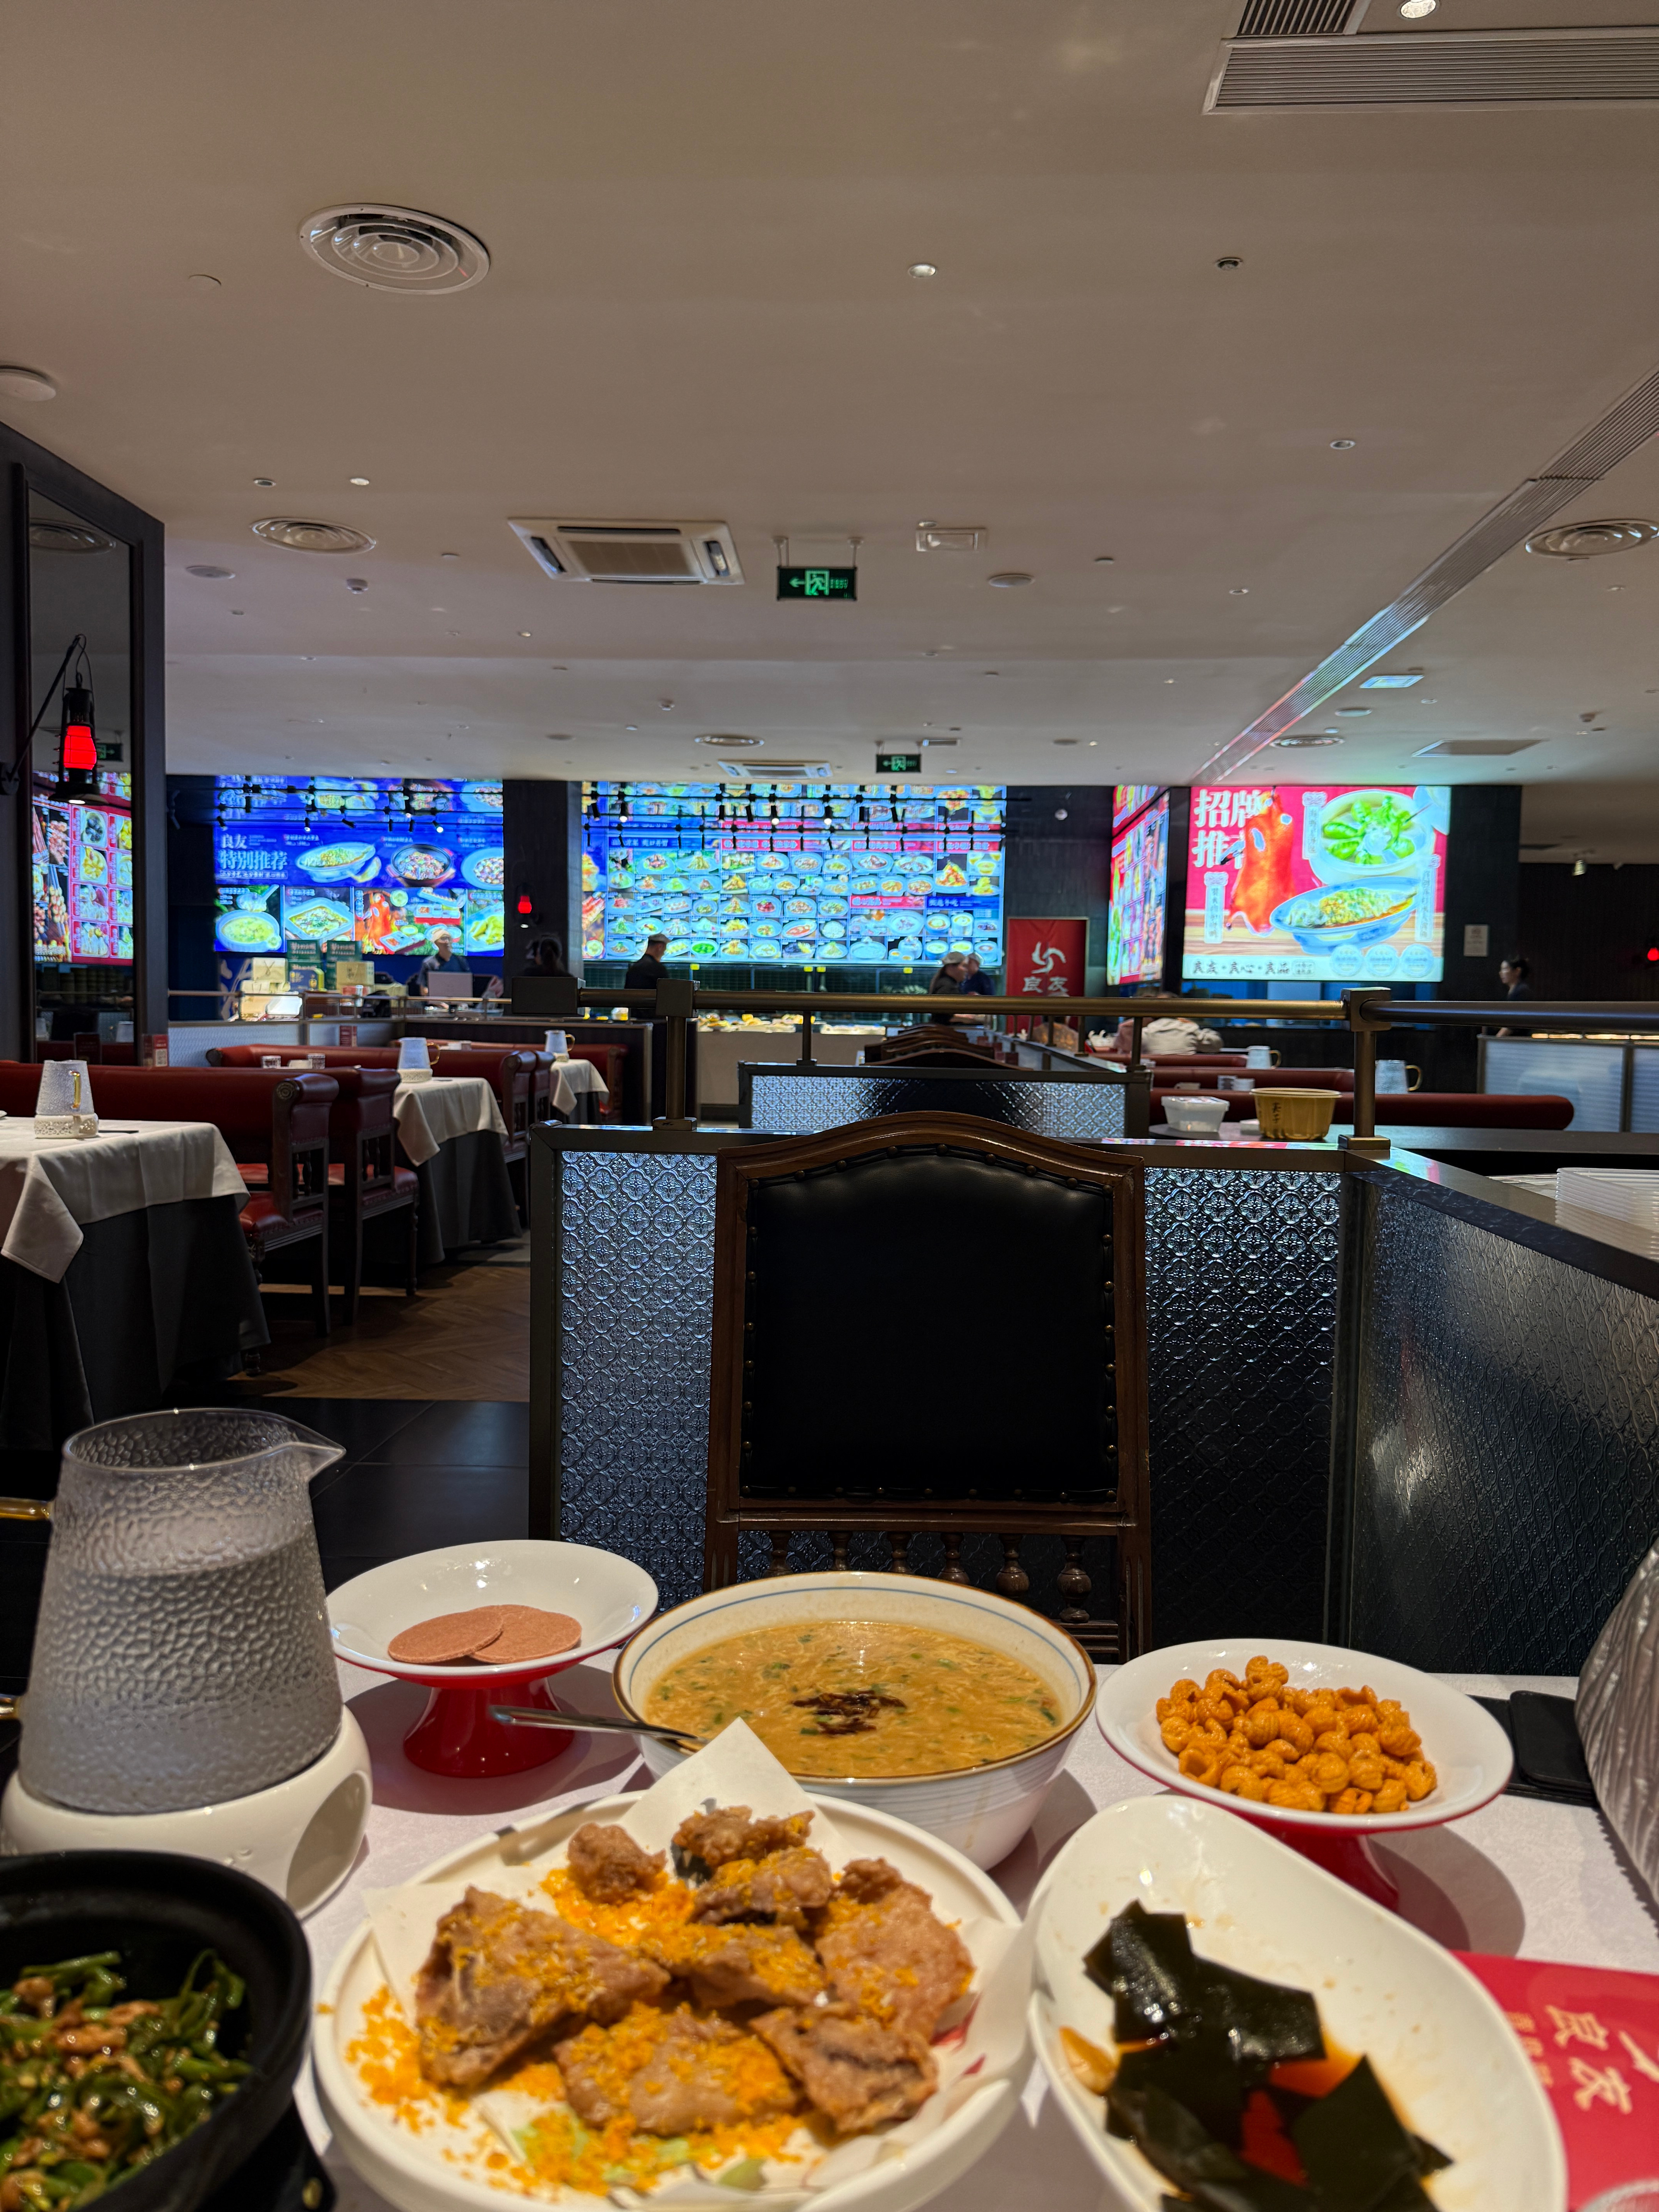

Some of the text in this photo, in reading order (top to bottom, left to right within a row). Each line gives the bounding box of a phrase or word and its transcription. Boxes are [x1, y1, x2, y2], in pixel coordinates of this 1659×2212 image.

[1194, 789, 1262, 828] 招牌
[222, 833, 247, 848] 良友
[1192, 830, 1245, 869] 推
[219, 848, 288, 870] 特别推荐
[1022, 976, 1069, 993] 良友
